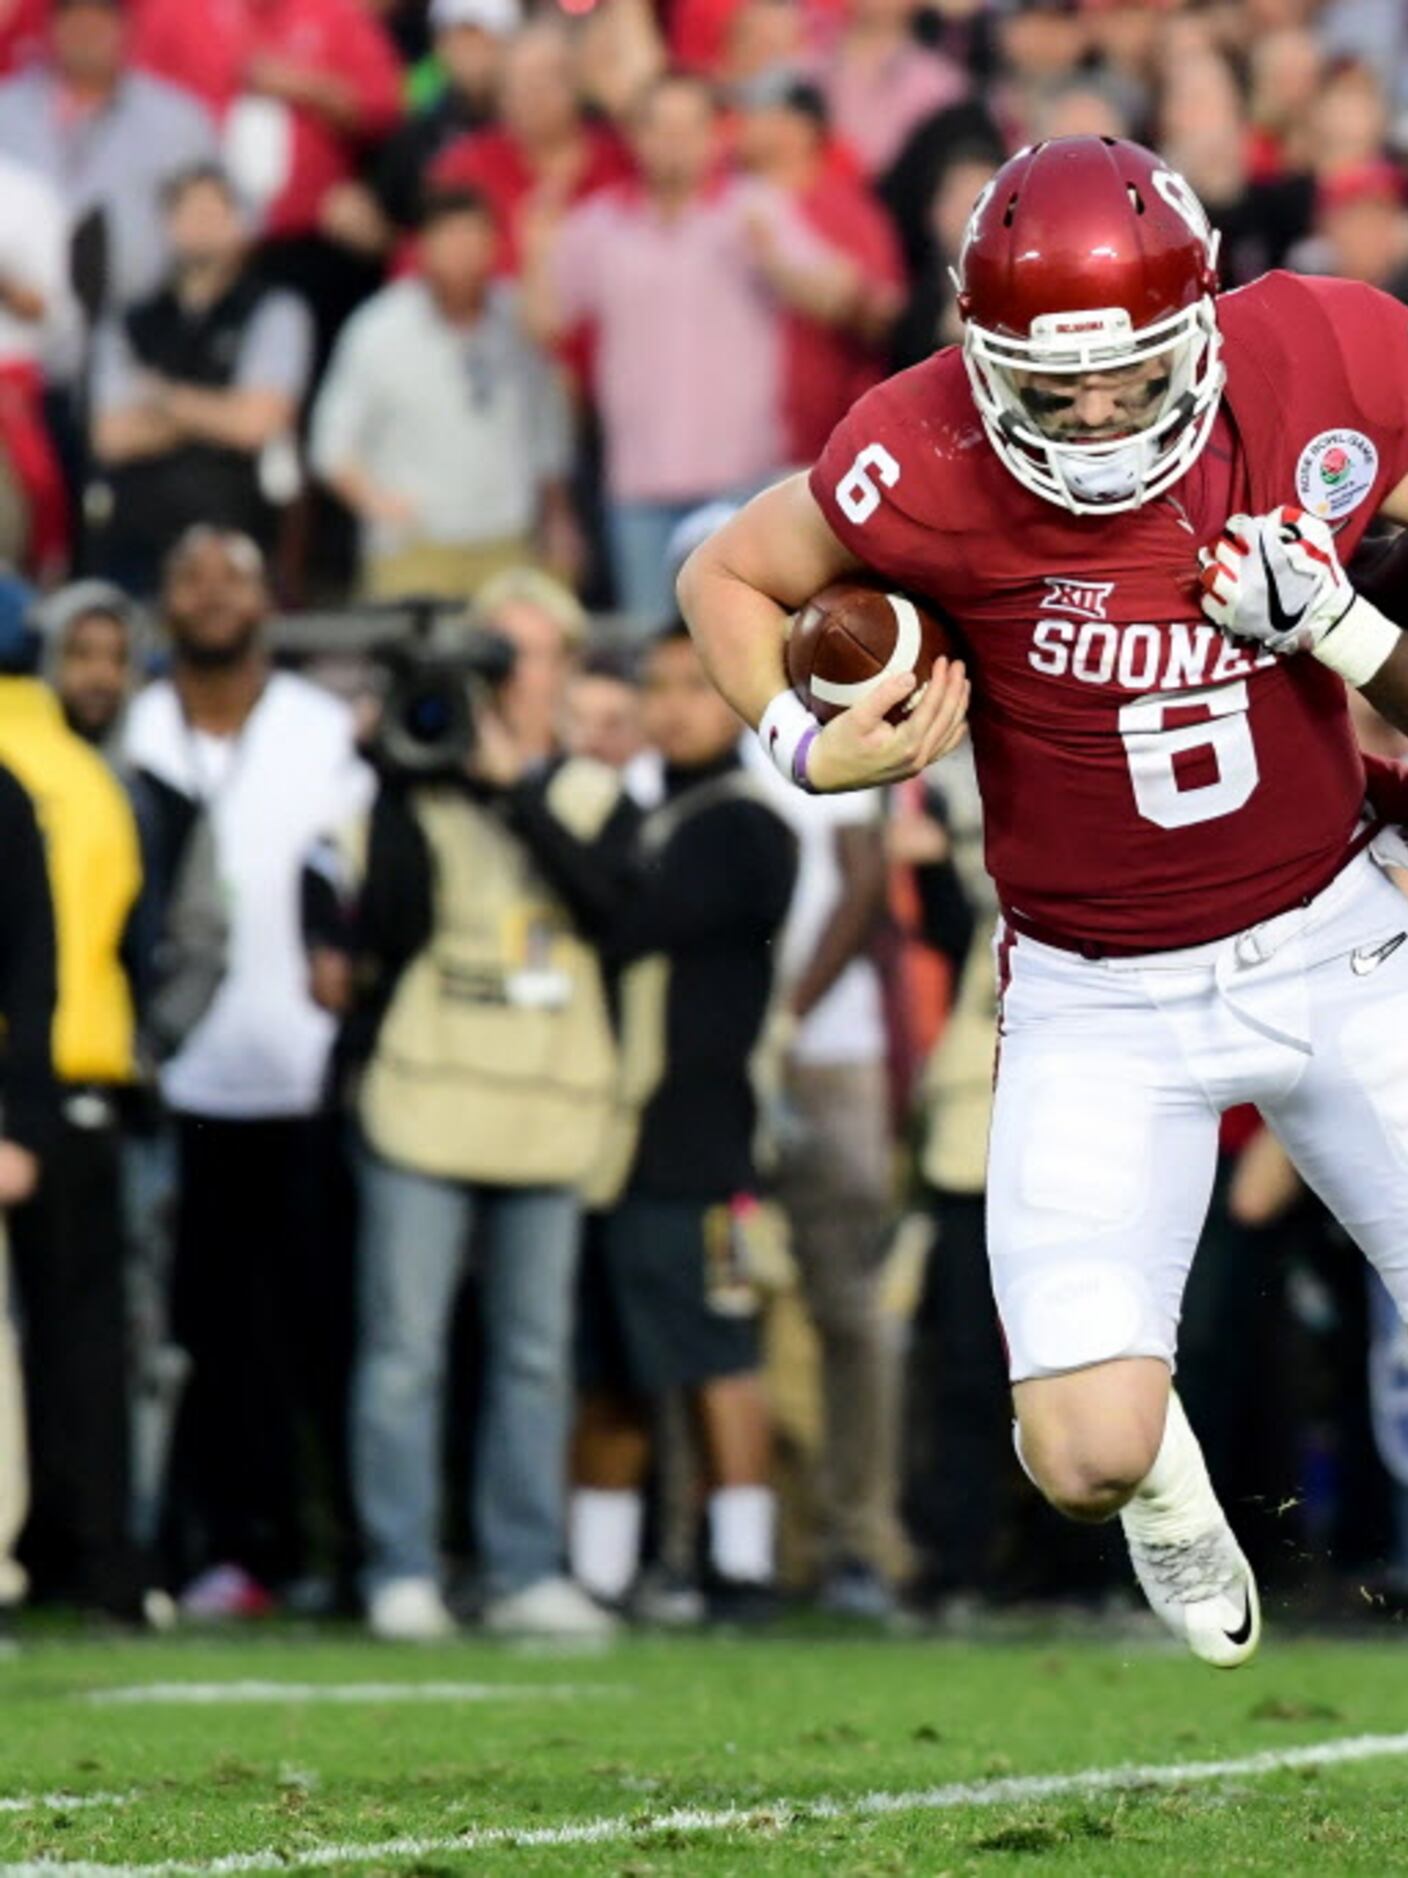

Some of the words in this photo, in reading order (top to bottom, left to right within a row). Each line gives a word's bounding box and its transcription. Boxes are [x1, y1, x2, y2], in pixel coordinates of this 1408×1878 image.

[835, 442, 901, 526] 6
[1310, 434, 1346, 457] BOWL
[1028, 618, 1278, 689] SOONE
[1118, 679, 1260, 830] 6
